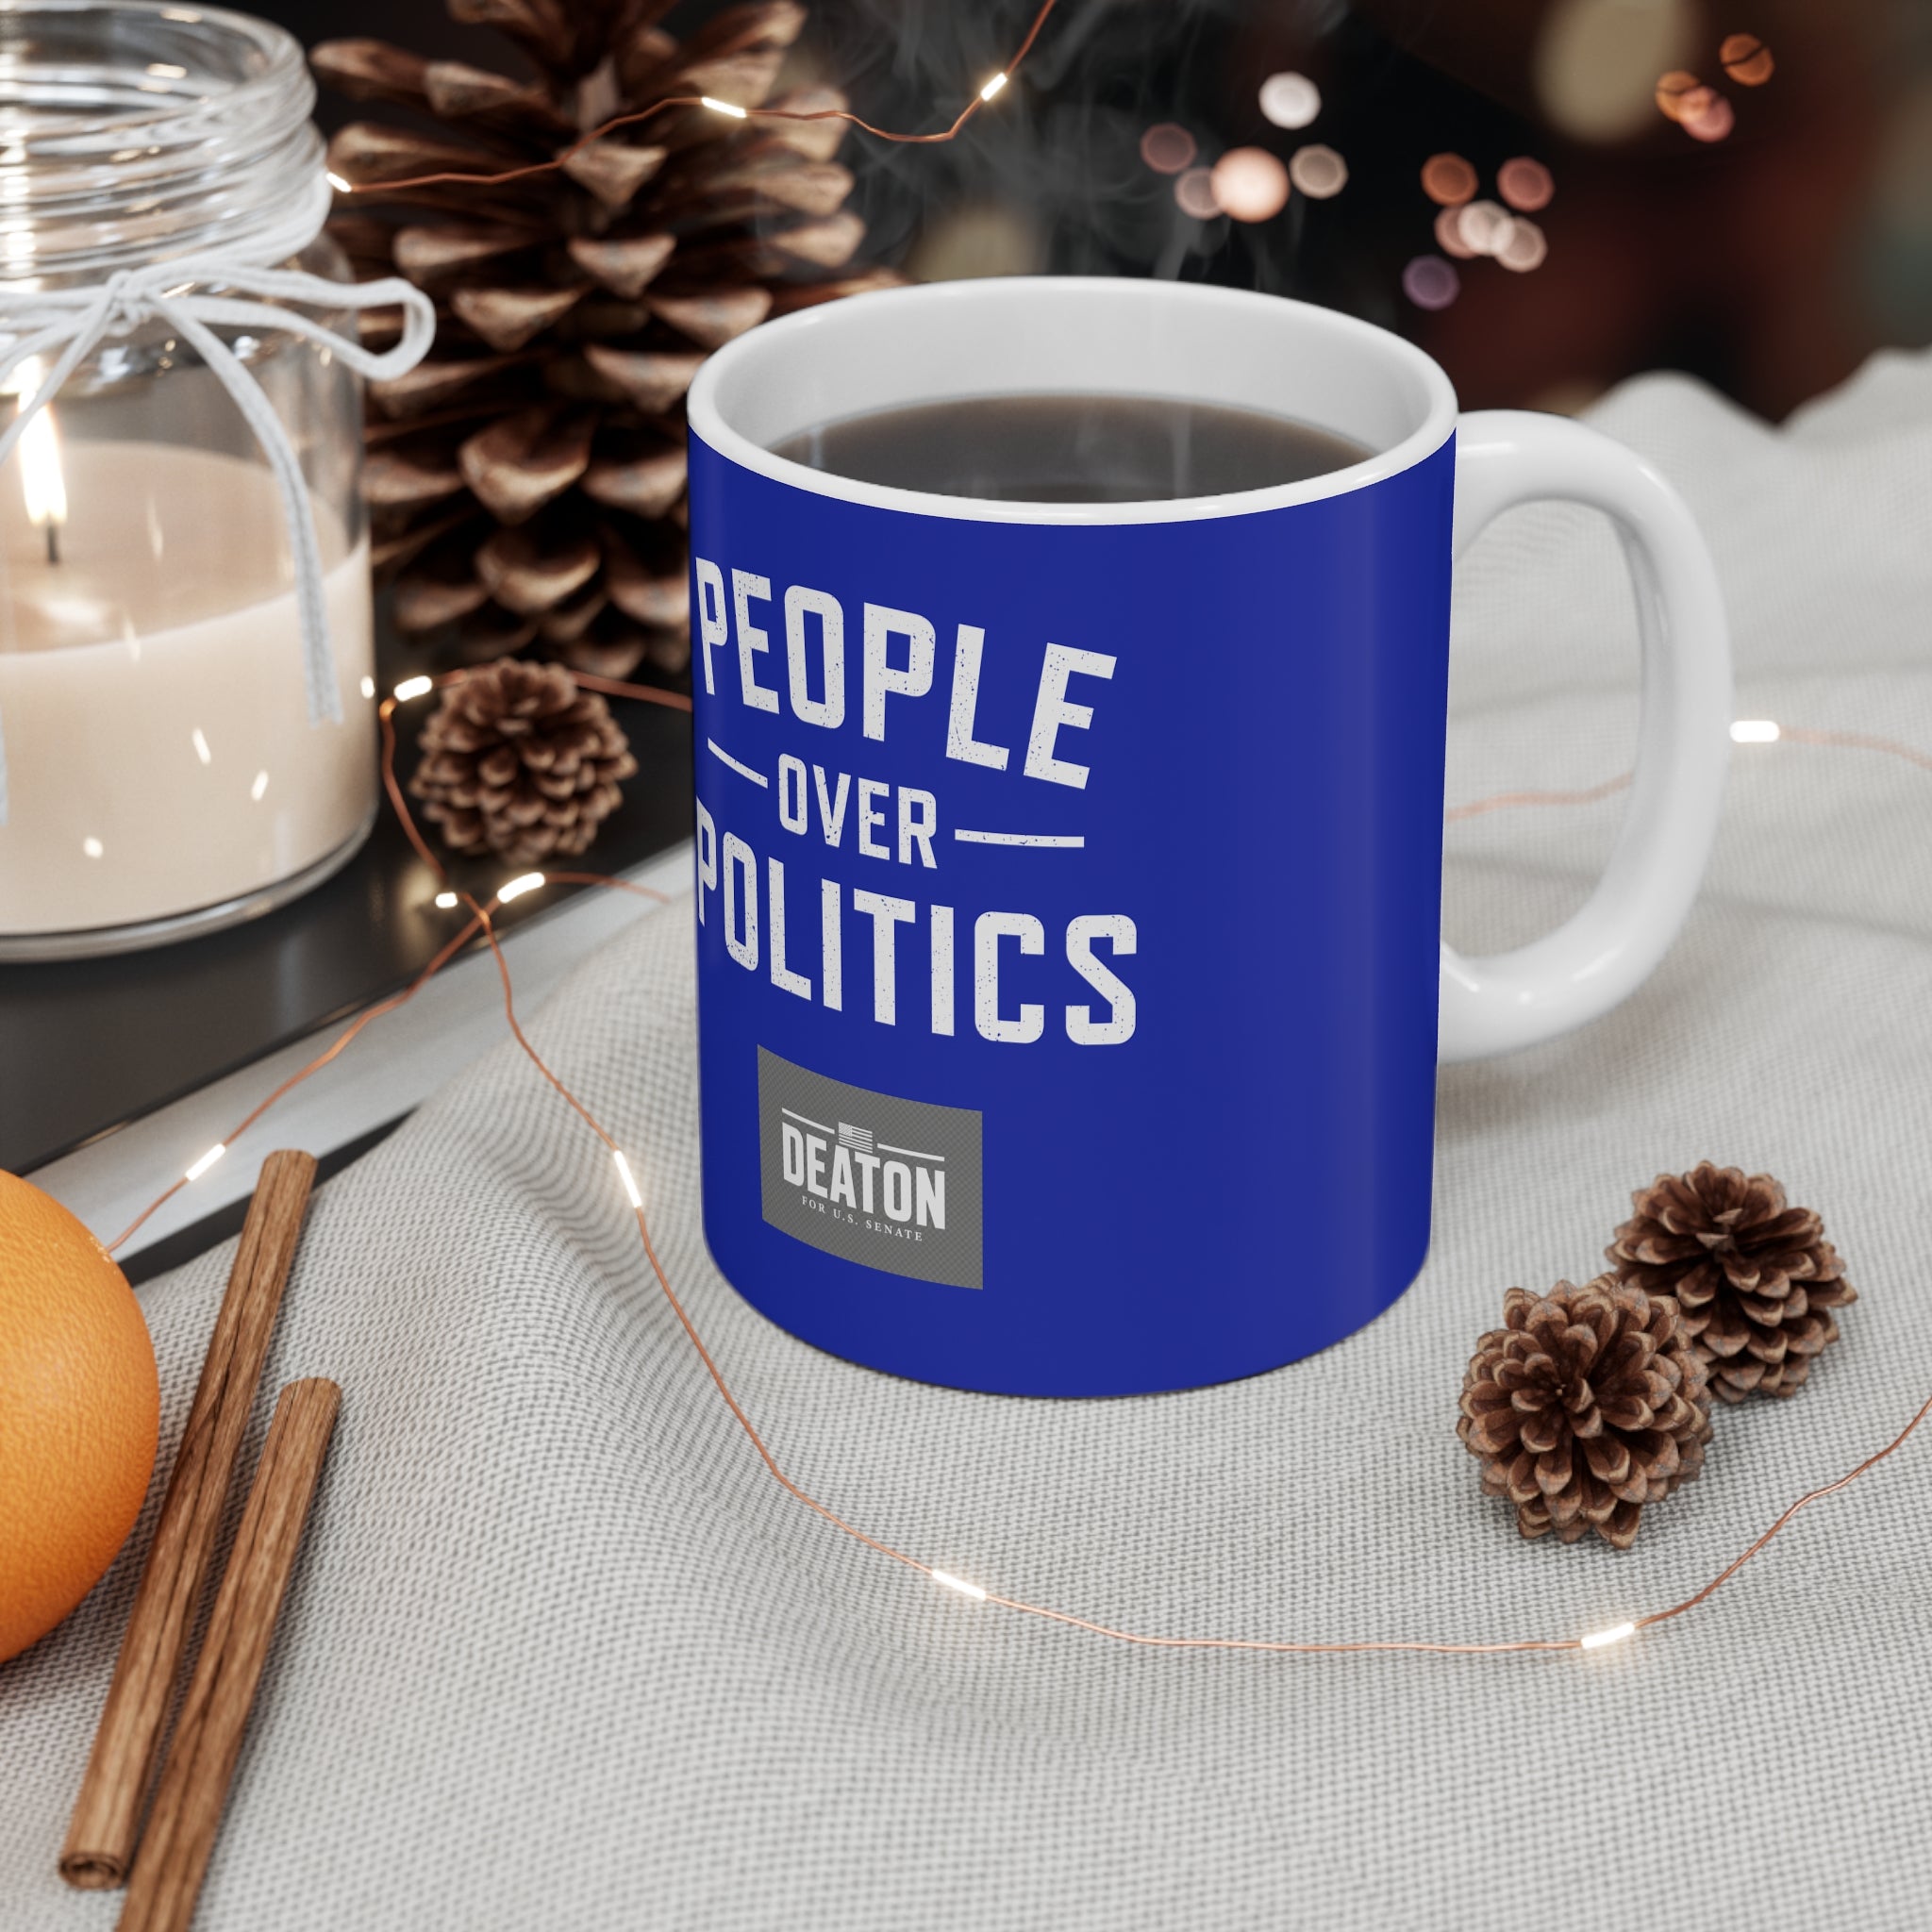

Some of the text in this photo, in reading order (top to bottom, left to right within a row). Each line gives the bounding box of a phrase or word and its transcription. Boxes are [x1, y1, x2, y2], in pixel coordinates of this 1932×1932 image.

[695, 557, 1118, 790] PEOPLE
[777, 752, 939, 870] OVER
[696, 795, 1138, 1046] POLITICS
[781, 1121, 946, 1230] DEATON
[802, 1195, 924, 1242] FOR U.S. SENATE
